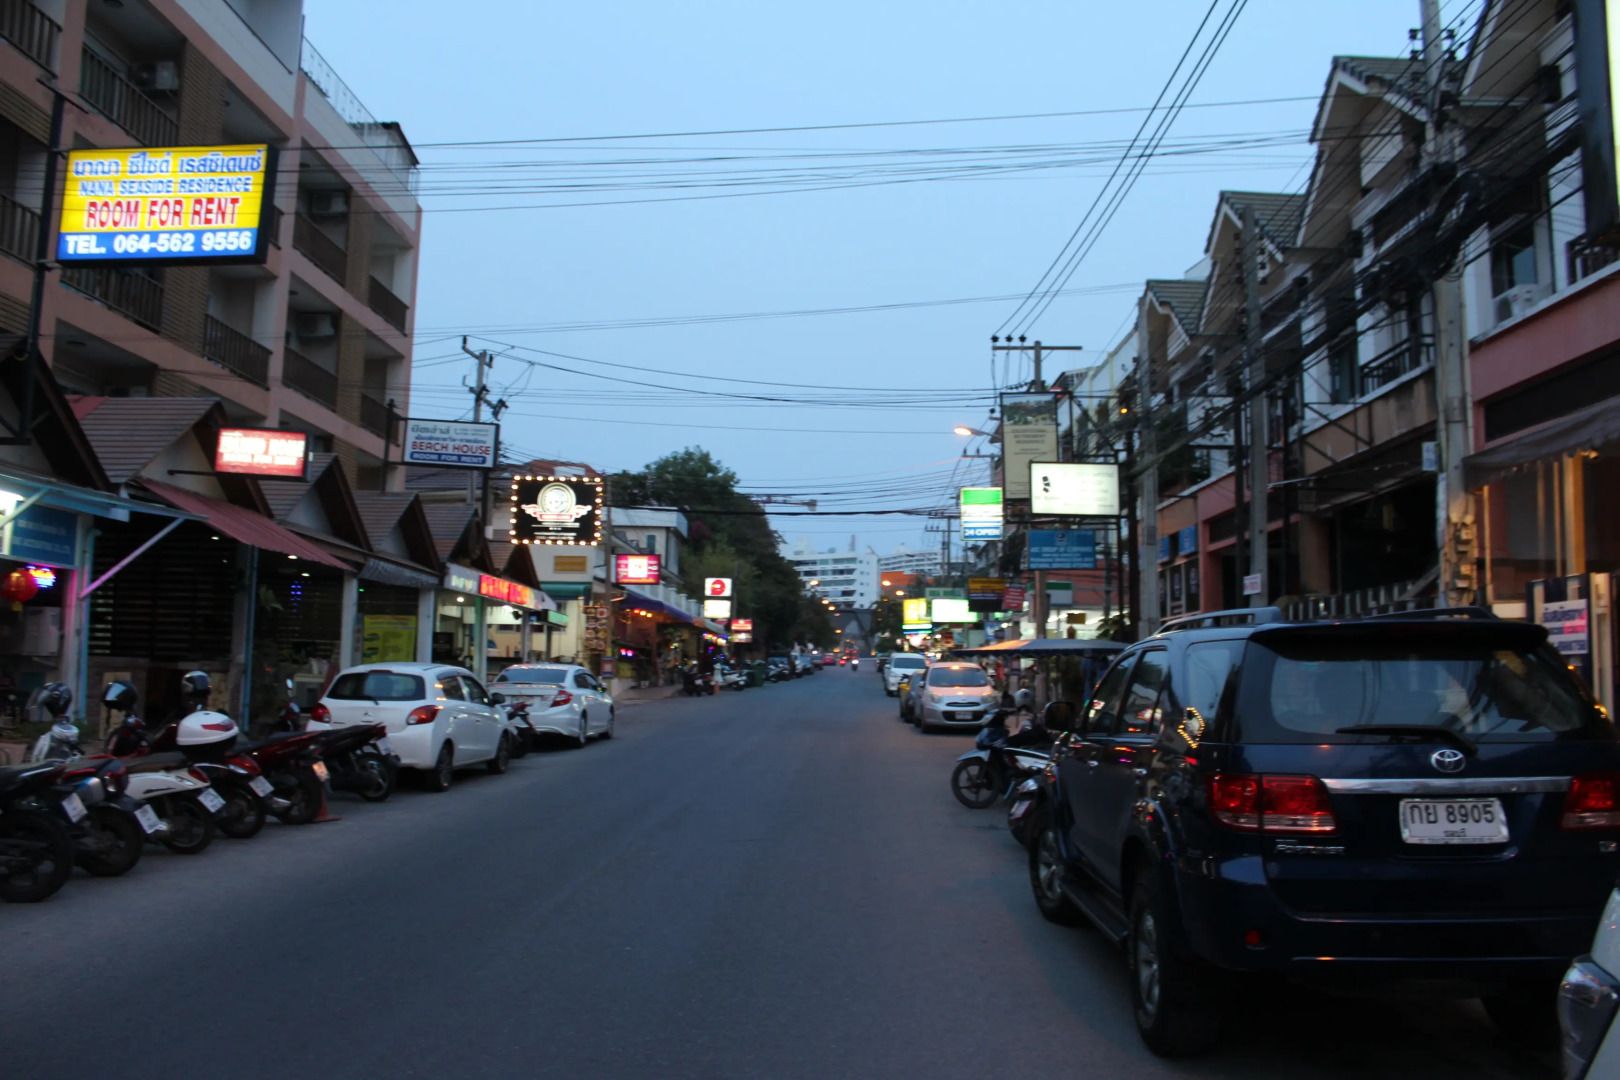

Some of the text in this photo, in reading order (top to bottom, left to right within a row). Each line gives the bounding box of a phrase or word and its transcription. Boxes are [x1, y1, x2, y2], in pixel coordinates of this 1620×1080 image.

[80, 177, 252, 196] NANA SEASIDE RESIDENCE
[86, 197, 240, 228] ROOM FOR RENT
[65, 231, 252, 254] TEL. 064-562 9556
[411, 441, 491, 455] BEACH HOUSE
[412, 453, 438, 461] ROOM
[1408, 803, 1495, 825] กย 8905
